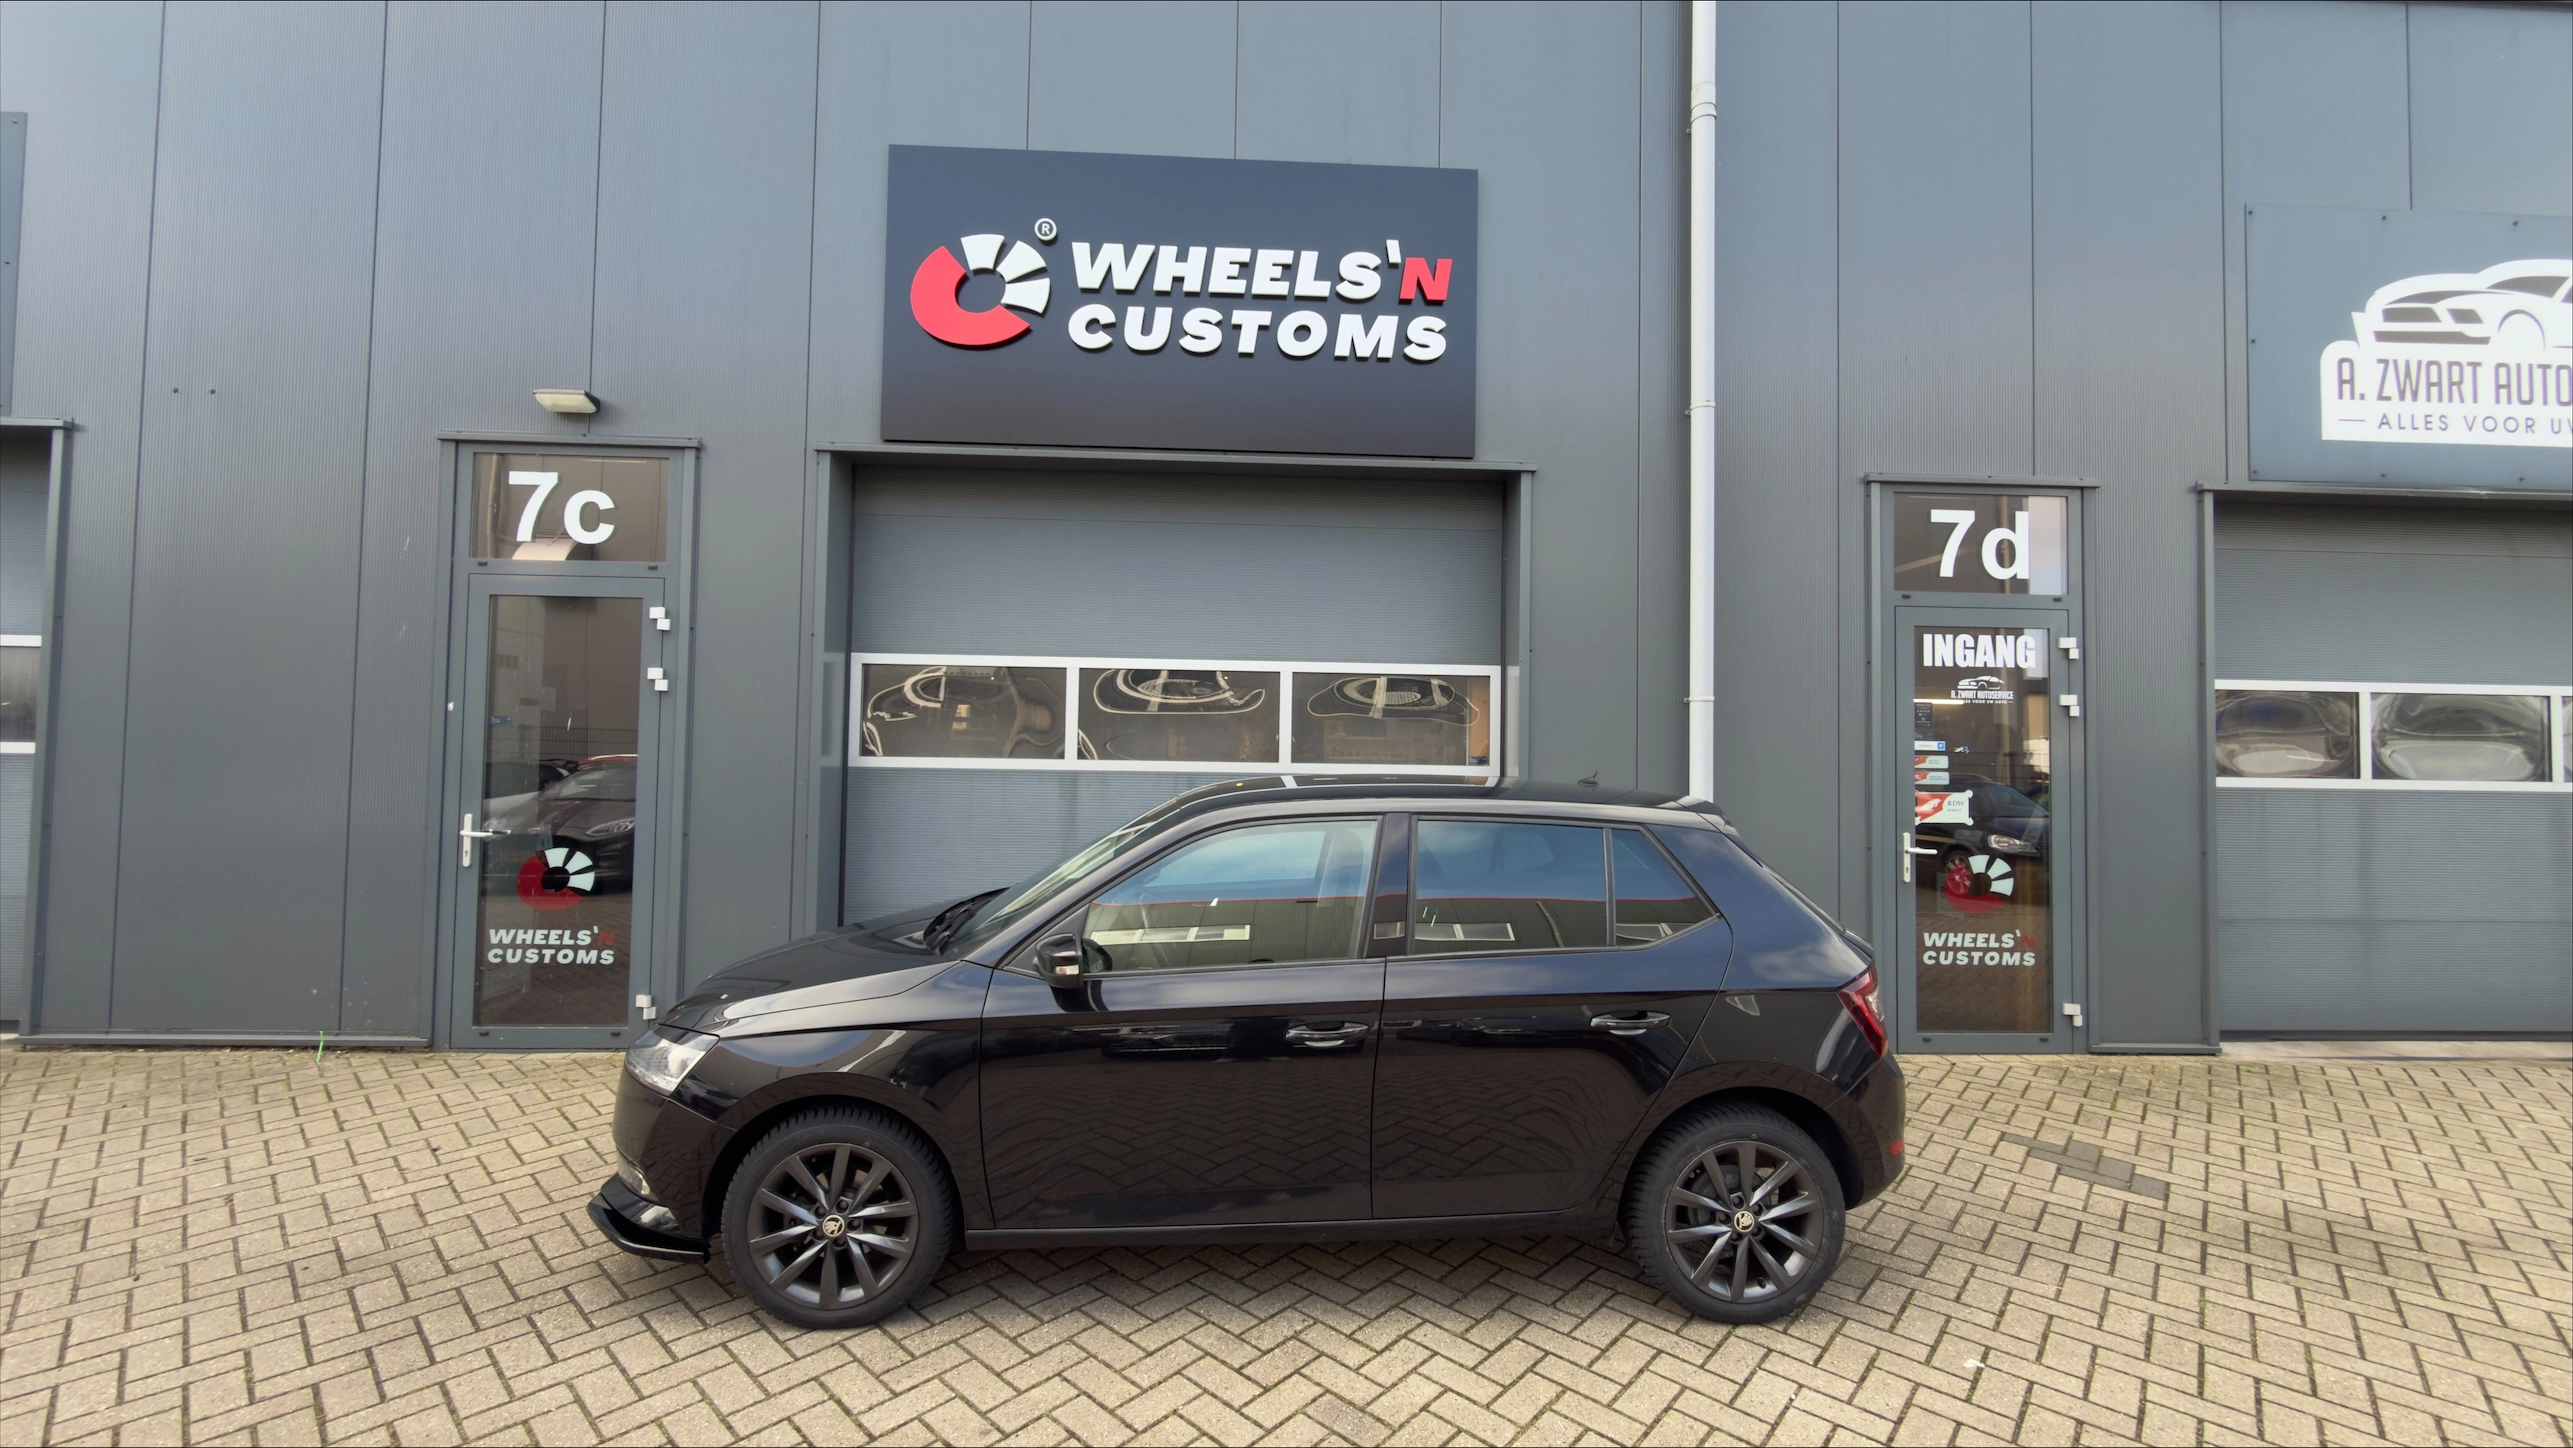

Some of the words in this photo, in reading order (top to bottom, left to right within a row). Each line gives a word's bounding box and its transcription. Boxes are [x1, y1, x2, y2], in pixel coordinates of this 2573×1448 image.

[1068, 303, 1447, 361] CUSTOMS
[2337, 357, 2365, 400] A.
[2376, 359, 2482, 405] ZWART
[2378, 413, 2449, 432] ALLES
[2463, 415, 2536, 434] VOOR
[508, 470, 615, 545] 7c
[1930, 508, 2030, 580] 7d
[1923, 633, 2036, 669] INGANG
[1957, 690, 1977, 699] ZWART
[487, 948, 615, 965] CUSTOMS
[1922, 951, 2036, 967] CUSTOMS
